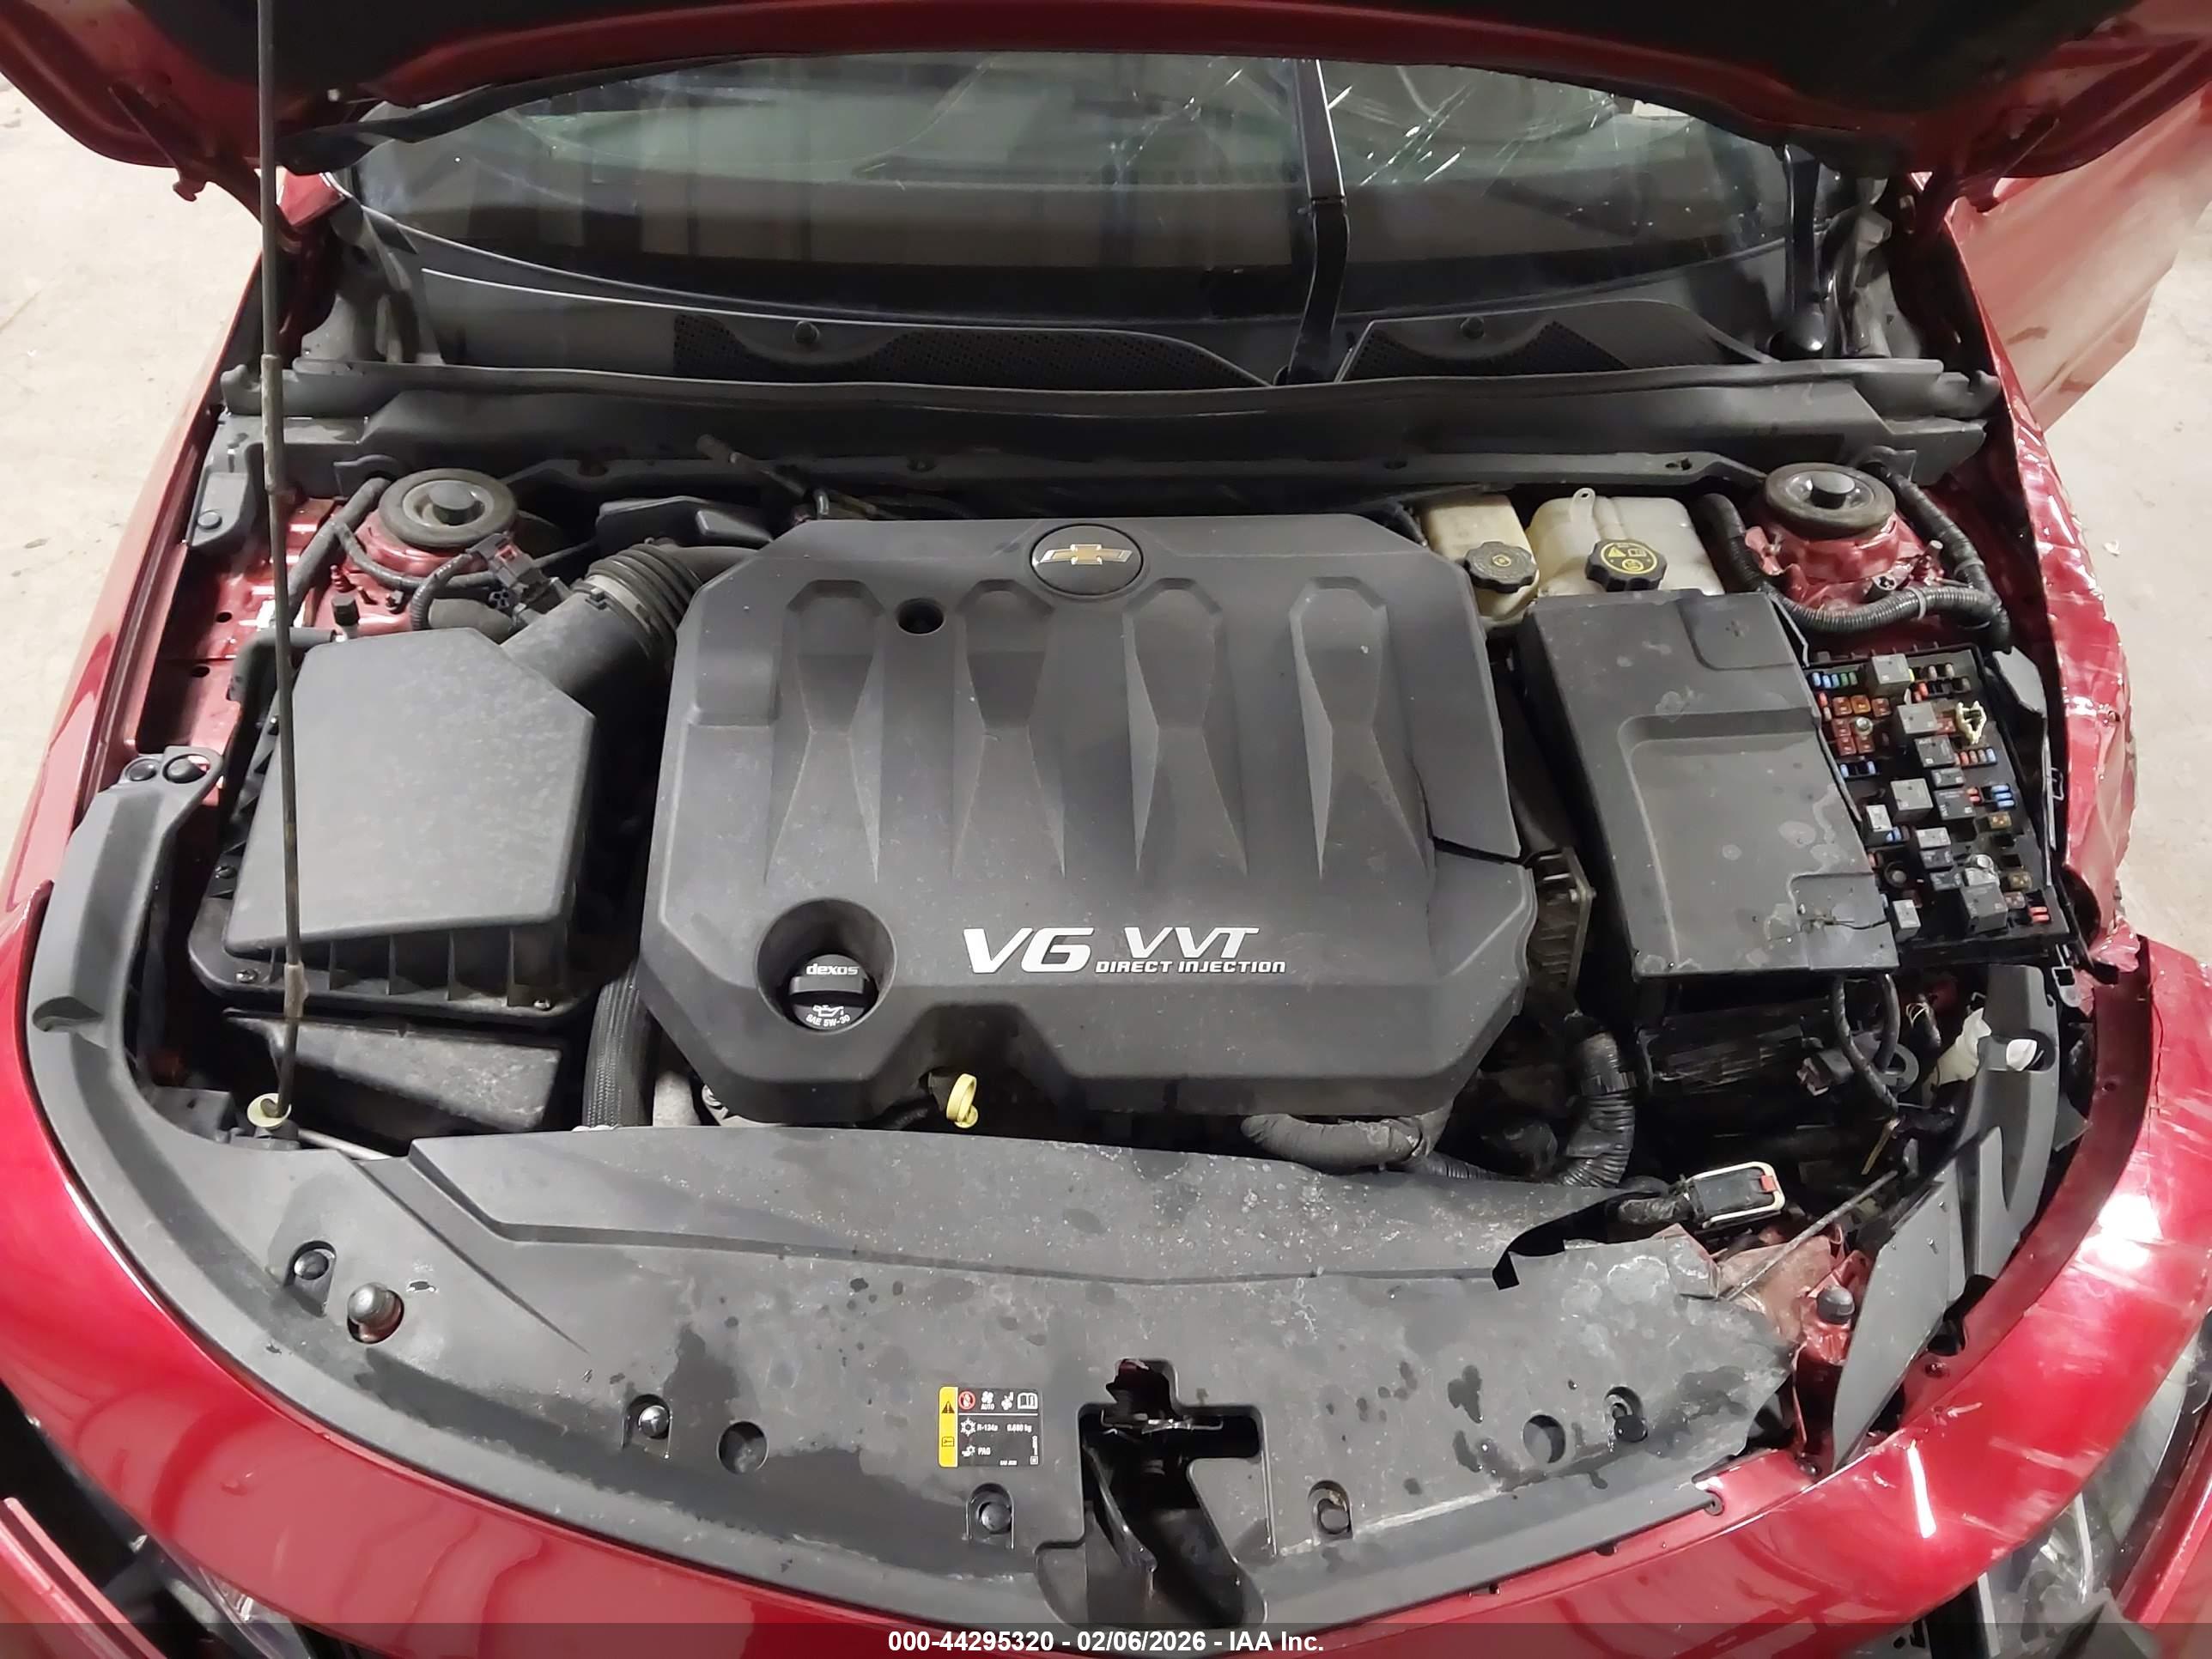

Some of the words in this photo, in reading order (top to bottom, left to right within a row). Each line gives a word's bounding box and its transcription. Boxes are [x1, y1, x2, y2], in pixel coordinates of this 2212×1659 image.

[963, 927, 1094, 974] V6
[1124, 927, 1260, 958] VVT
[805, 963, 860, 975] dexos
[1095, 960, 1173, 973] DIRECT
[1177, 960, 1285, 973] INJECTION
[805, 1014, 822, 1026] SAE
[823, 1014, 851, 1027] 5W-30
[977, 1447, 991, 1455] PAG
